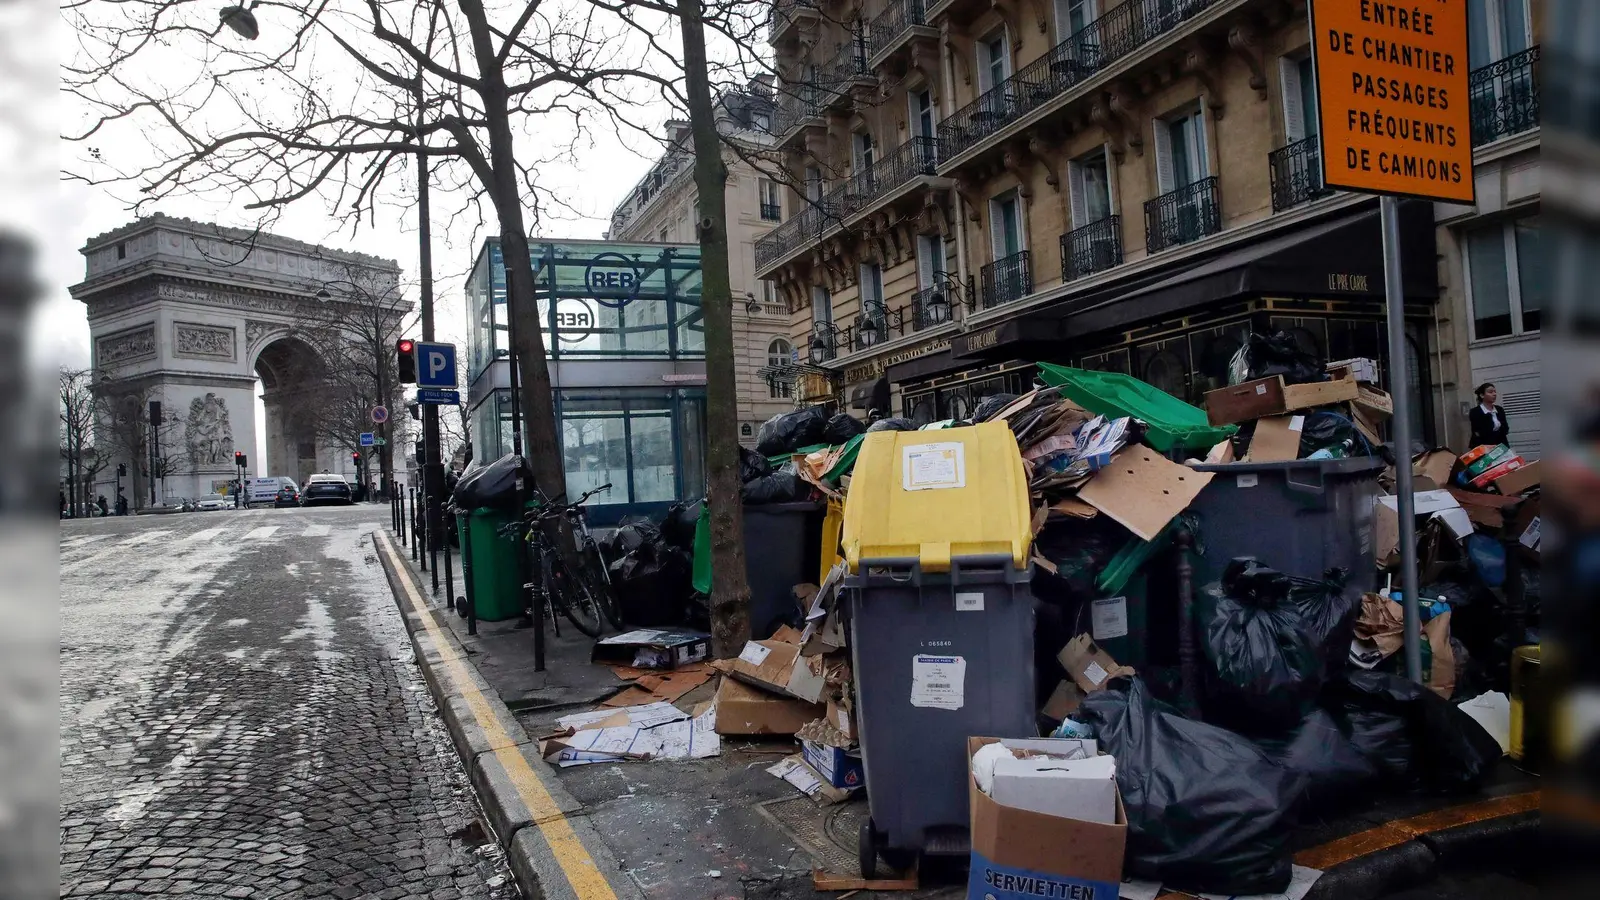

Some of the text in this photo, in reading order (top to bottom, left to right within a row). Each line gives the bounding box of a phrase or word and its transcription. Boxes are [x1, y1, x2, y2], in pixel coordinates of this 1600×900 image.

[1360, 0, 1434, 36] ENTRÉE
[1329, 29, 1454, 75] DE CHANTIER
[1352, 72, 1449, 110] PASSAGES
[1348, 109, 1457, 147] FRÉQUENTS
[1346, 147, 1462, 183] DE CAMIONS
[591, 271, 634, 289] RER
[1328, 273, 1336, 290] LE
[967, 336, 974, 351] LE
[428, 351, 447, 379] P
[984, 867, 1095, 900] SERVIETTEN
